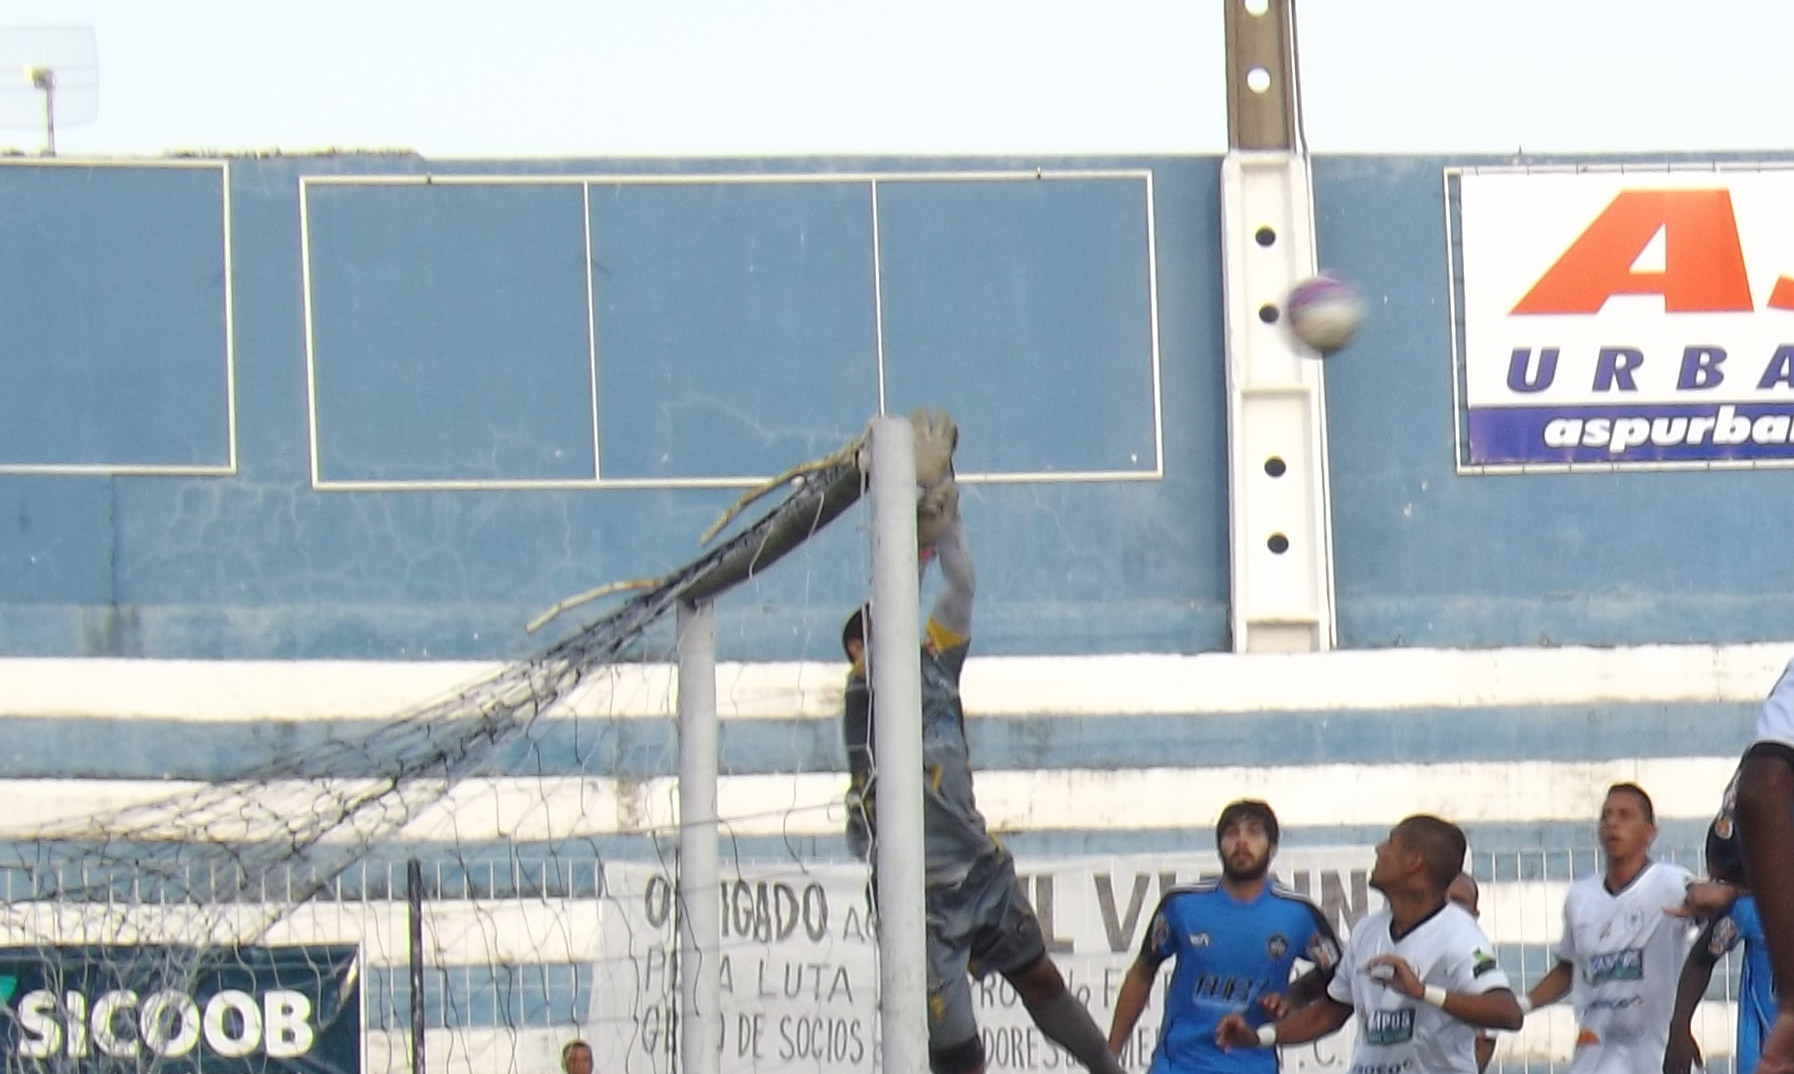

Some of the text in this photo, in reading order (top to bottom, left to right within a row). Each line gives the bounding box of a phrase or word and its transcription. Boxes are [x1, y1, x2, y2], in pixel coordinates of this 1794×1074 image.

[757, 957, 853, 1003] LUTA
[17, 988, 315, 1059] SICOOB
[737, 1012, 765, 1059] DE
